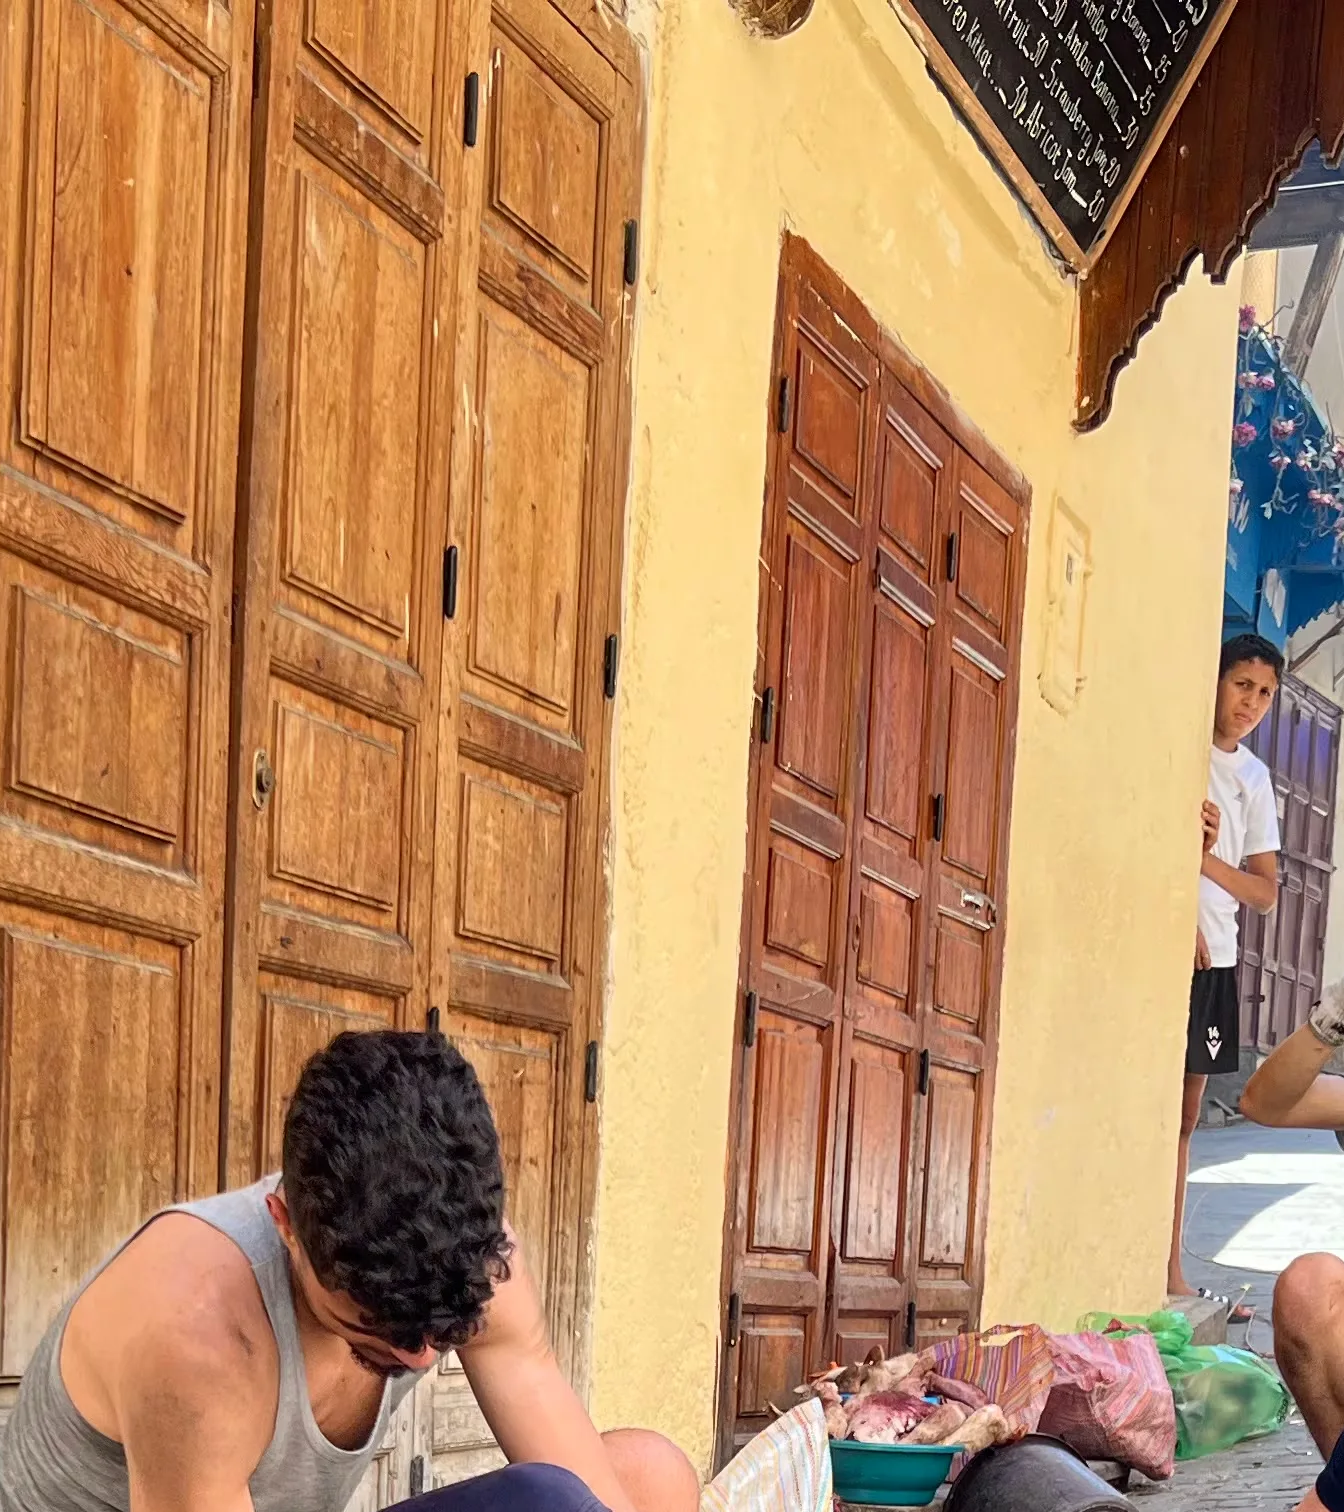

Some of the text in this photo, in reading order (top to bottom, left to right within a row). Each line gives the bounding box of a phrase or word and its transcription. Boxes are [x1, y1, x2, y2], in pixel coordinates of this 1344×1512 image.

[1030, 32, 1049, 68] 30
[1172, 19, 1189, 52] 20
[1155, 54, 1172, 84] 25
[1007, 76, 1029, 118] 30
[1091, 60, 1119, 123] Banana
[1121, 116, 1139, 149] 30
[1140, 84, 1155, 116] 25
[1044, 58, 1093, 161] Strawberry
[1104, 157, 1121, 188] 20
[1024, 100, 1105, 222] Abricot Jam 20
[1207, 1026, 1220, 1040] 14
